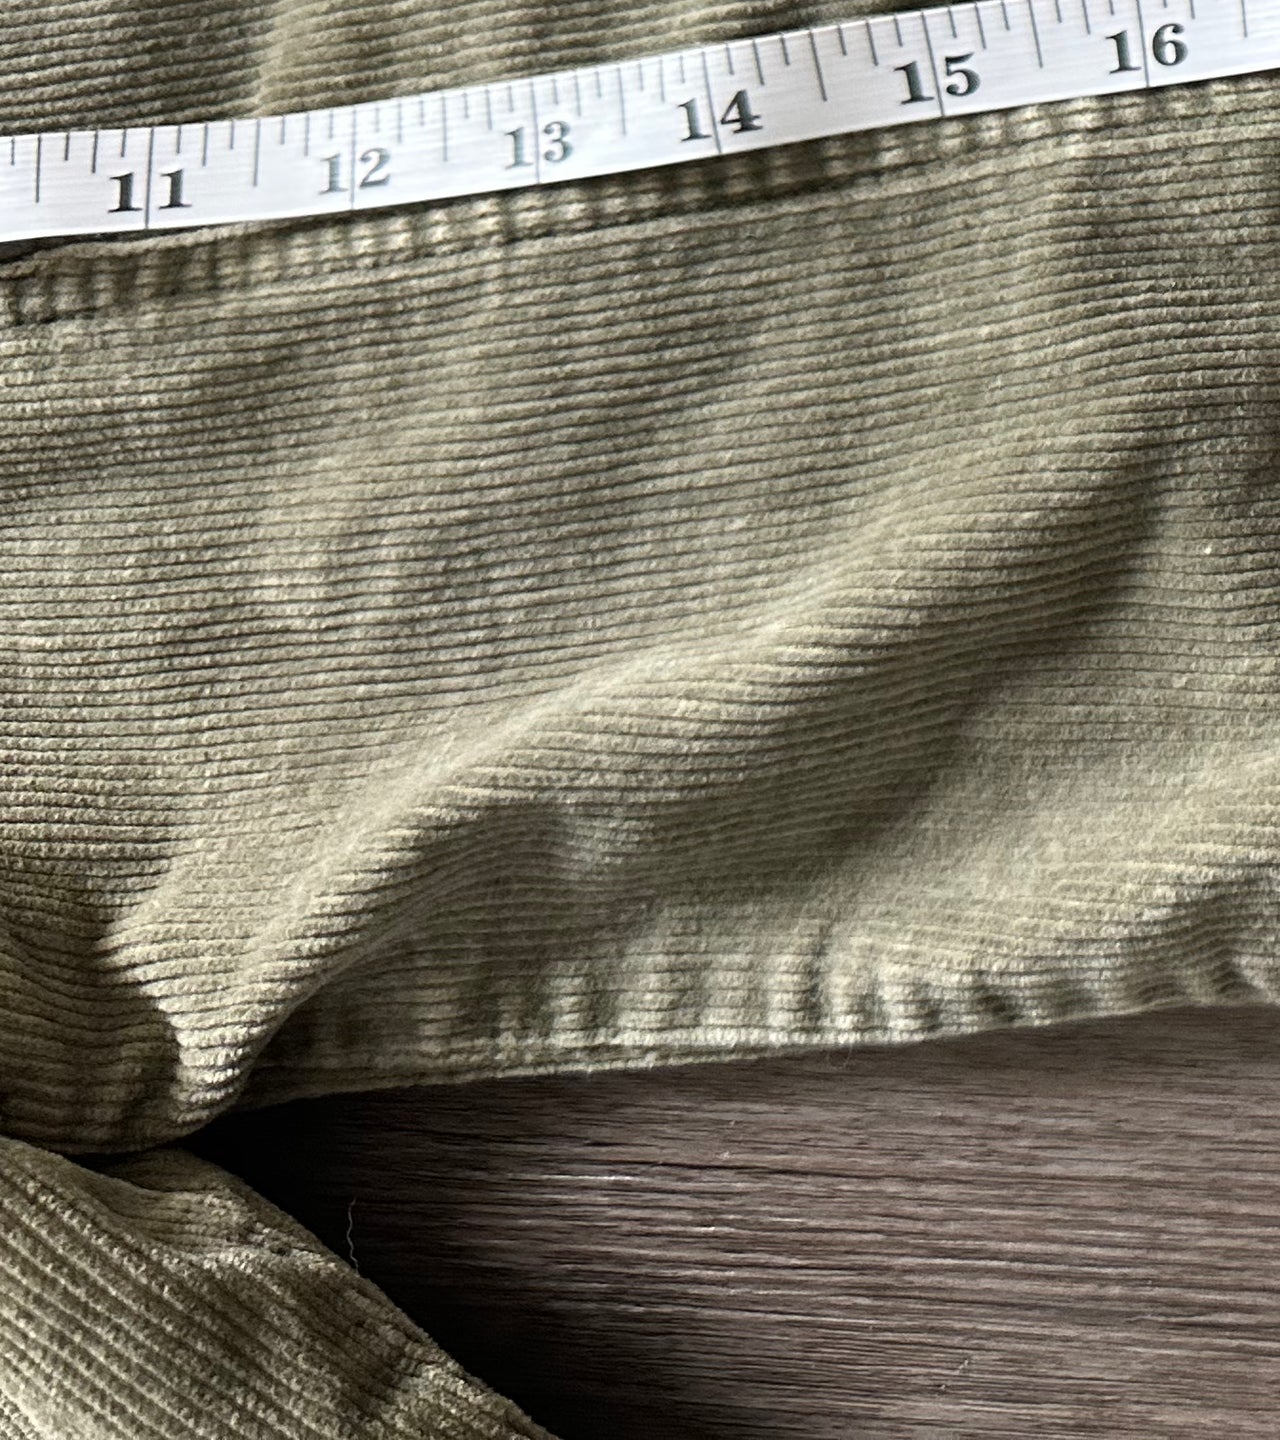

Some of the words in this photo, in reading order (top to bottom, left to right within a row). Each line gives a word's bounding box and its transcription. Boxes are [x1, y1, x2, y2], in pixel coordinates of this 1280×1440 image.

[107, 168, 191, 214] 11
[319, 147, 391, 195] 12
[503, 120, 575, 170] 13
[677, 89, 764, 142] 14
[892, 52, 982, 106] 15
[1105, 22, 1189, 75] 16
